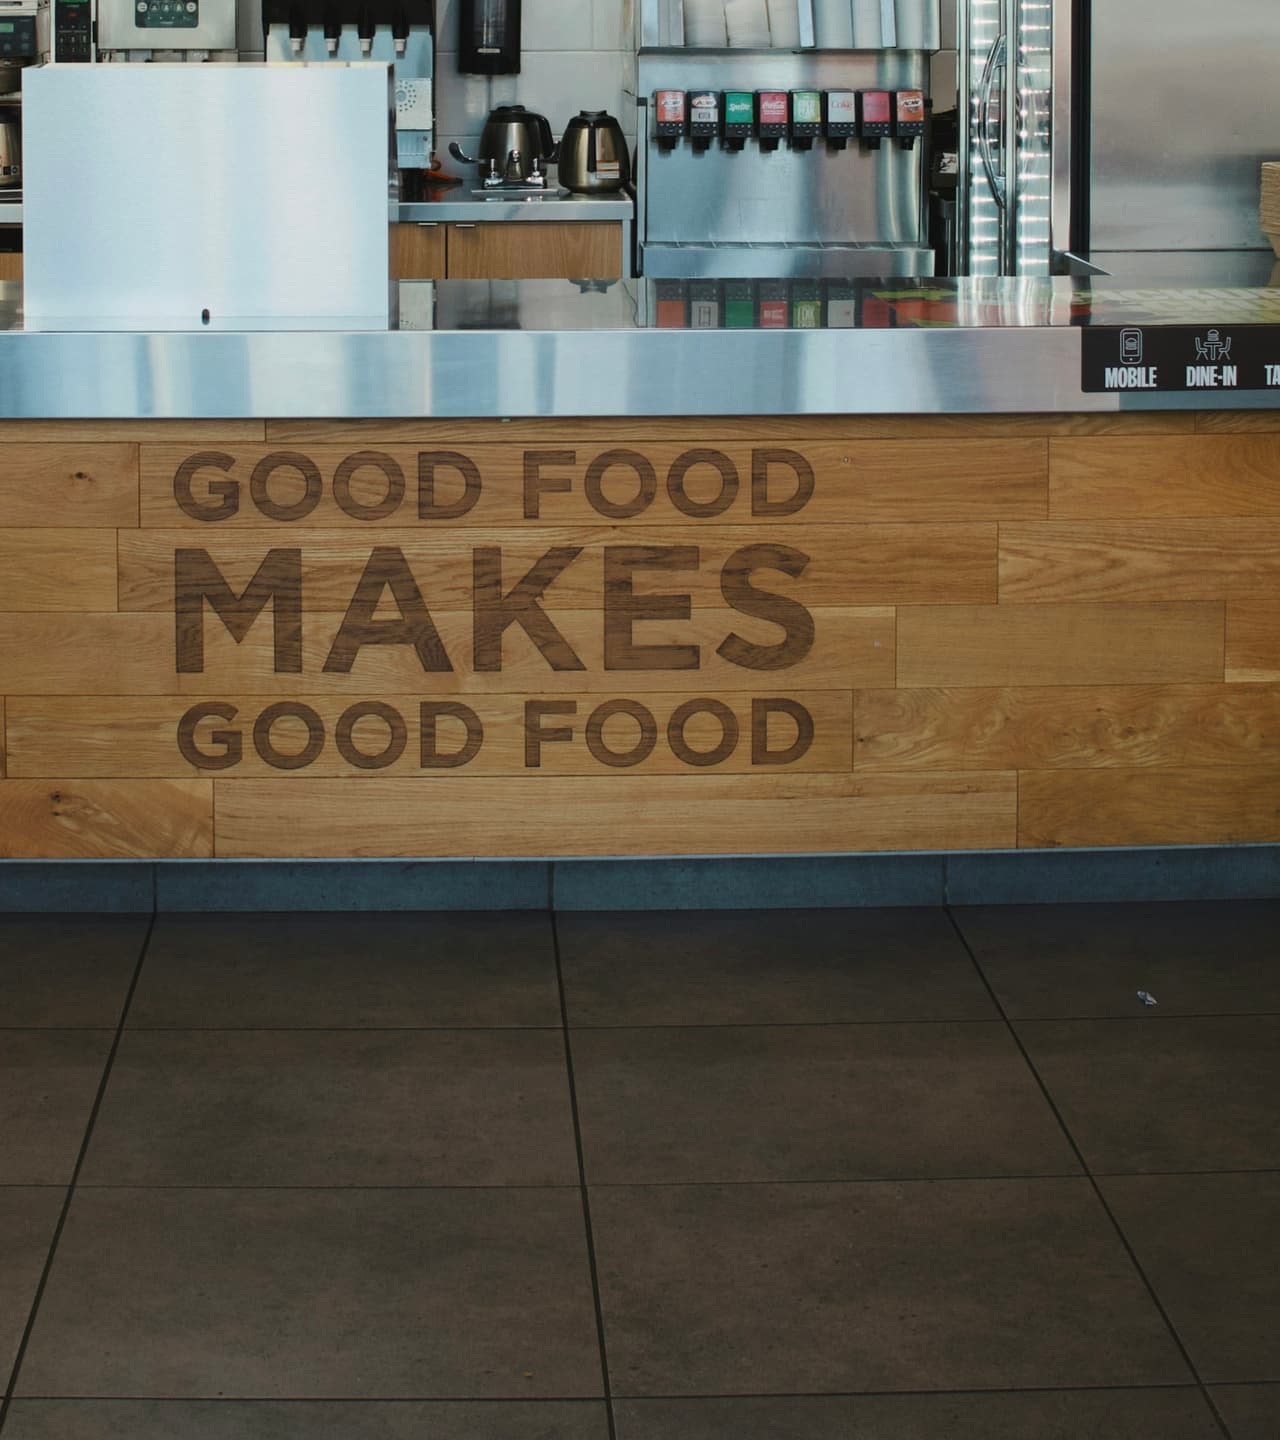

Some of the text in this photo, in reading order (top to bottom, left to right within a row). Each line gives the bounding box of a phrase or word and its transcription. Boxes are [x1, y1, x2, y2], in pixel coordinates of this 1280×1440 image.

[1105, 367, 1157, 388] MOBILE
[1186, 365, 1237, 387] DINE-IN
[173, 448, 815, 522] GOOD FOOD
[174, 544, 815, 674] MAKES
[177, 698, 815, 770] GOOD FOOD
